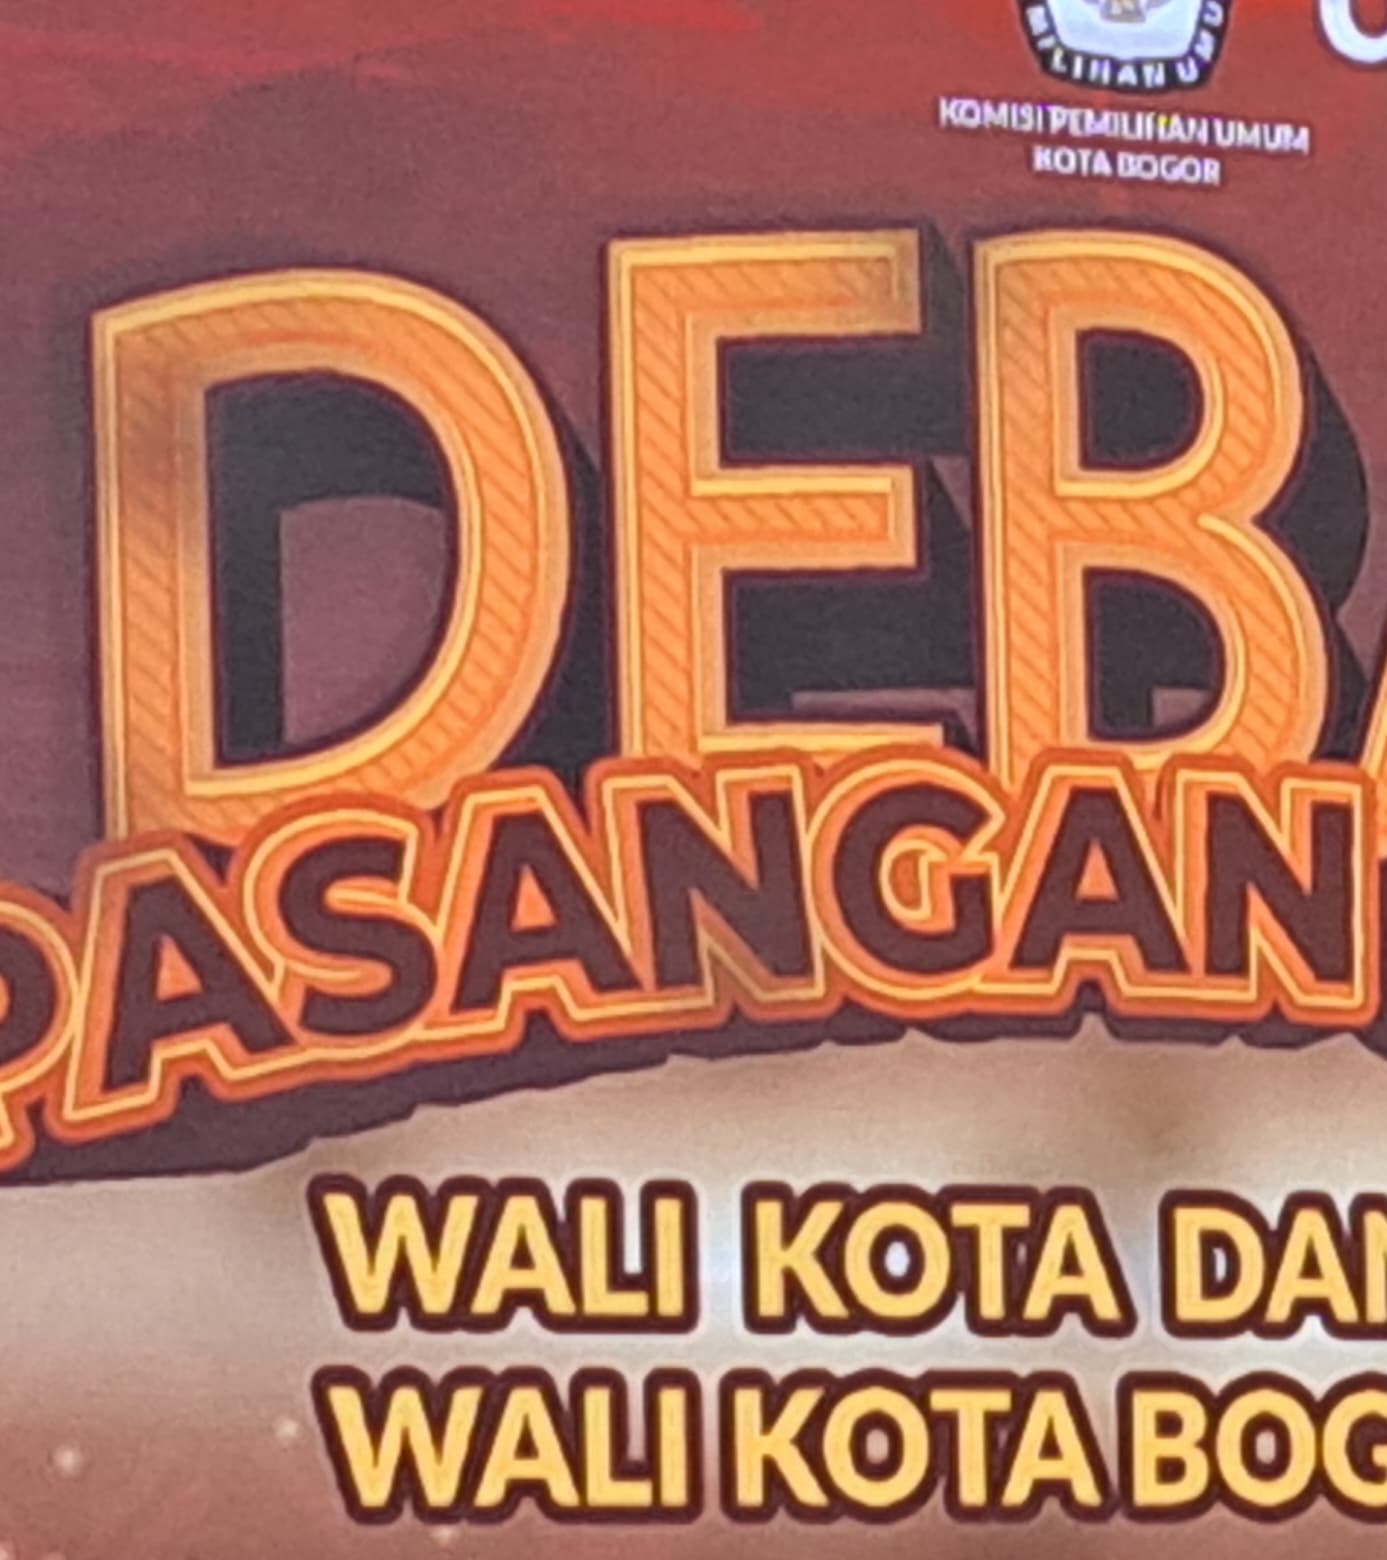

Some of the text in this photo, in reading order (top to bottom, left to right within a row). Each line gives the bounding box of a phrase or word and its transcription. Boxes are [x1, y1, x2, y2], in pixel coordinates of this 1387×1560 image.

[939, 98, 1310, 155] KOMISI PEMILIHAN UMUM
[1033, 146, 1221, 185] KOTA BOGOR
[0, 752, 1372, 1155] PASANGAN
[320, 1192, 685, 1318] WALI
[752, 1198, 1126, 1322] KOTA
[326, 1385, 689, 1508] WALI
[732, 1386, 1103, 1510] KOTA
